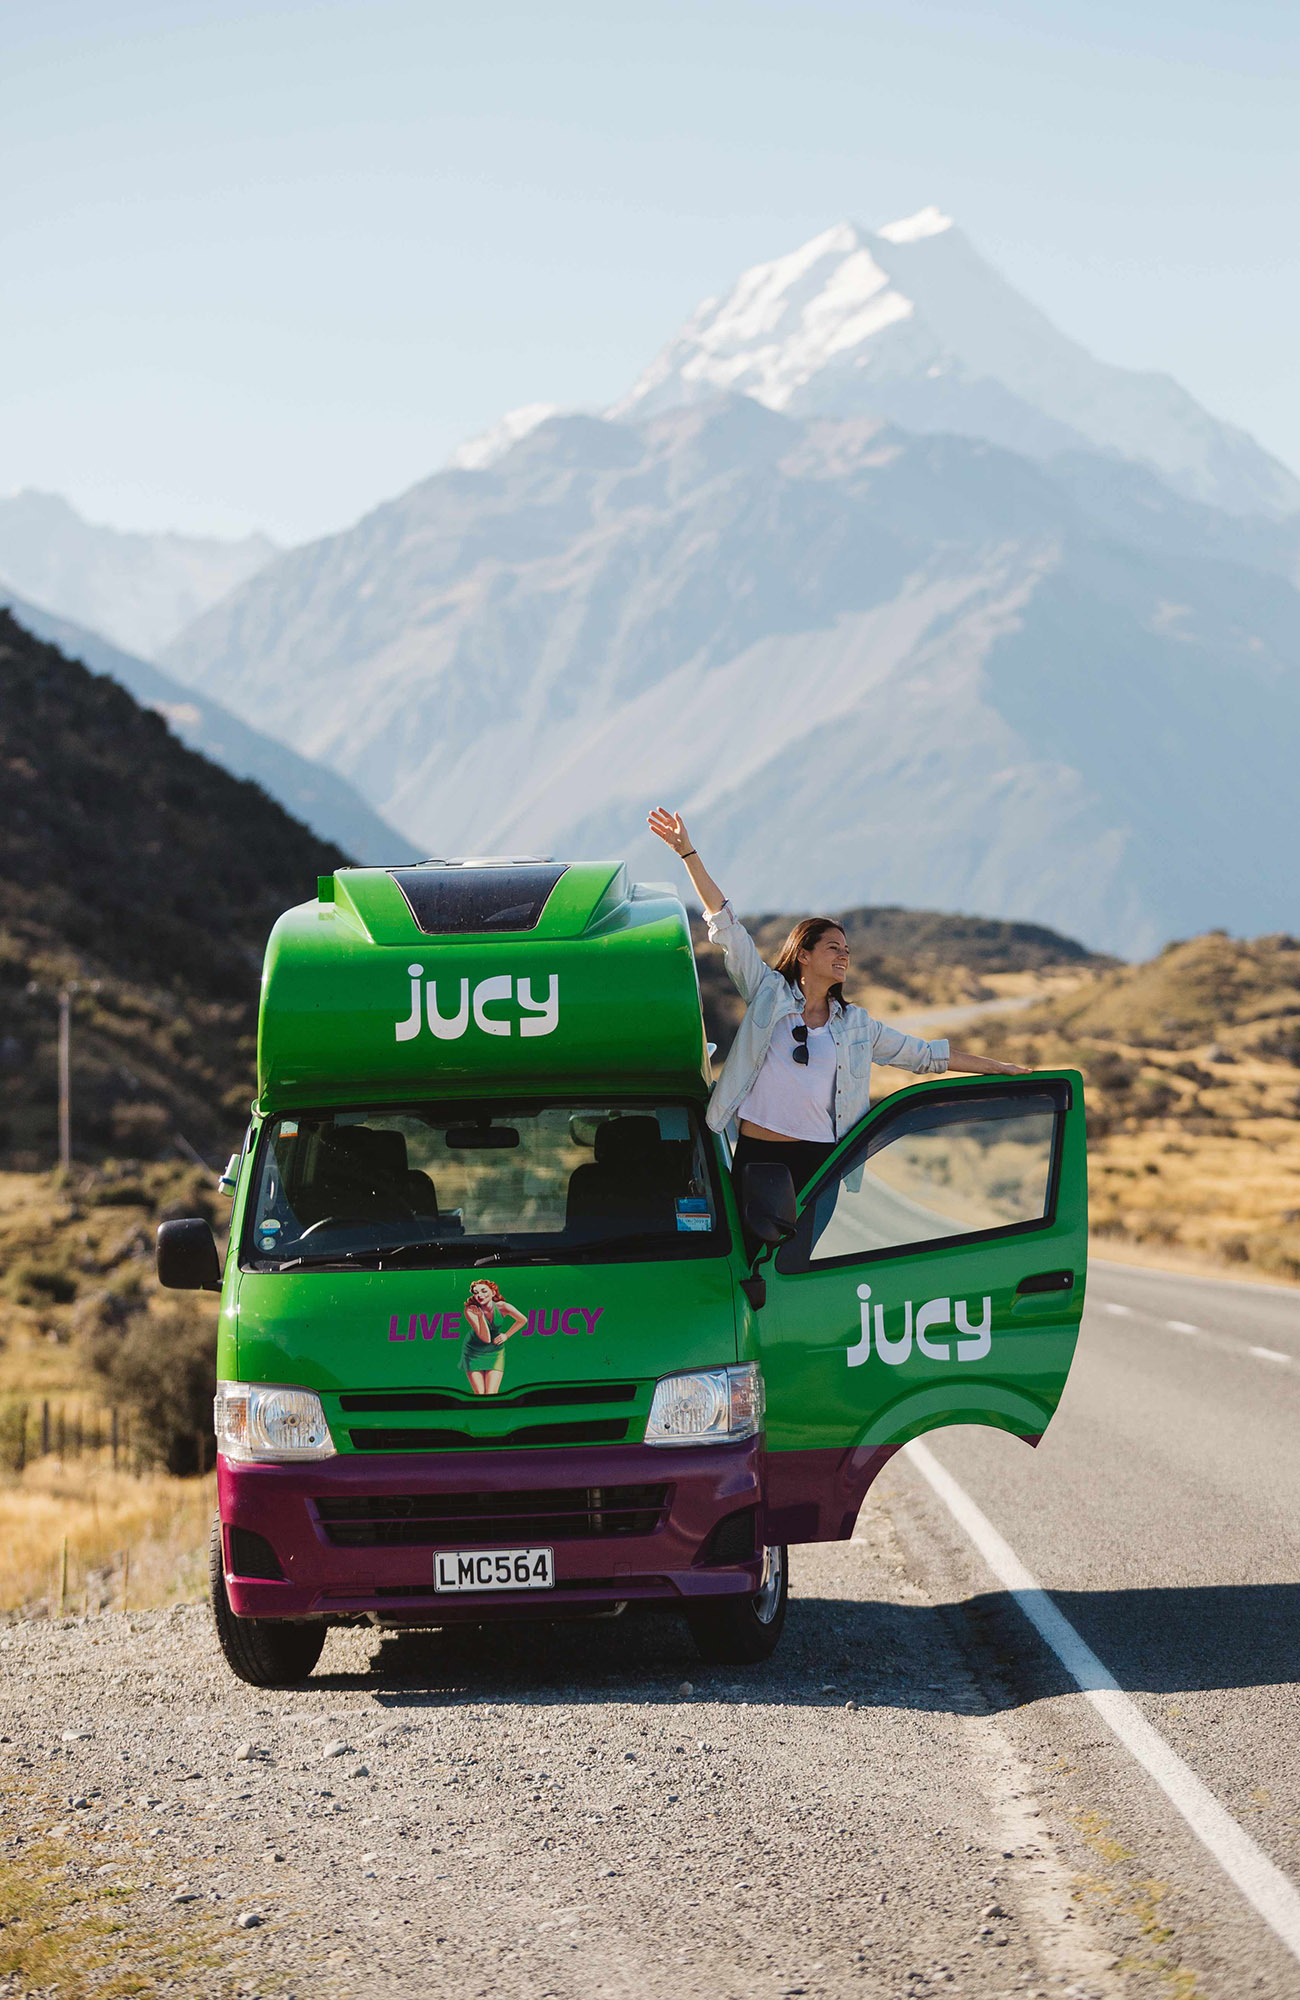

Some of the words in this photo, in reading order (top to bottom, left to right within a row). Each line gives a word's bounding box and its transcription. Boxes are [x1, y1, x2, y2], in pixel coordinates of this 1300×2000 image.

[395, 963, 559, 1042] jucy
[388, 1312, 462, 1342] LIVE
[521, 1307, 605, 1337] JUCY
[846, 1283, 992, 1368] jucy
[439, 1554, 548, 1585] LMC564
